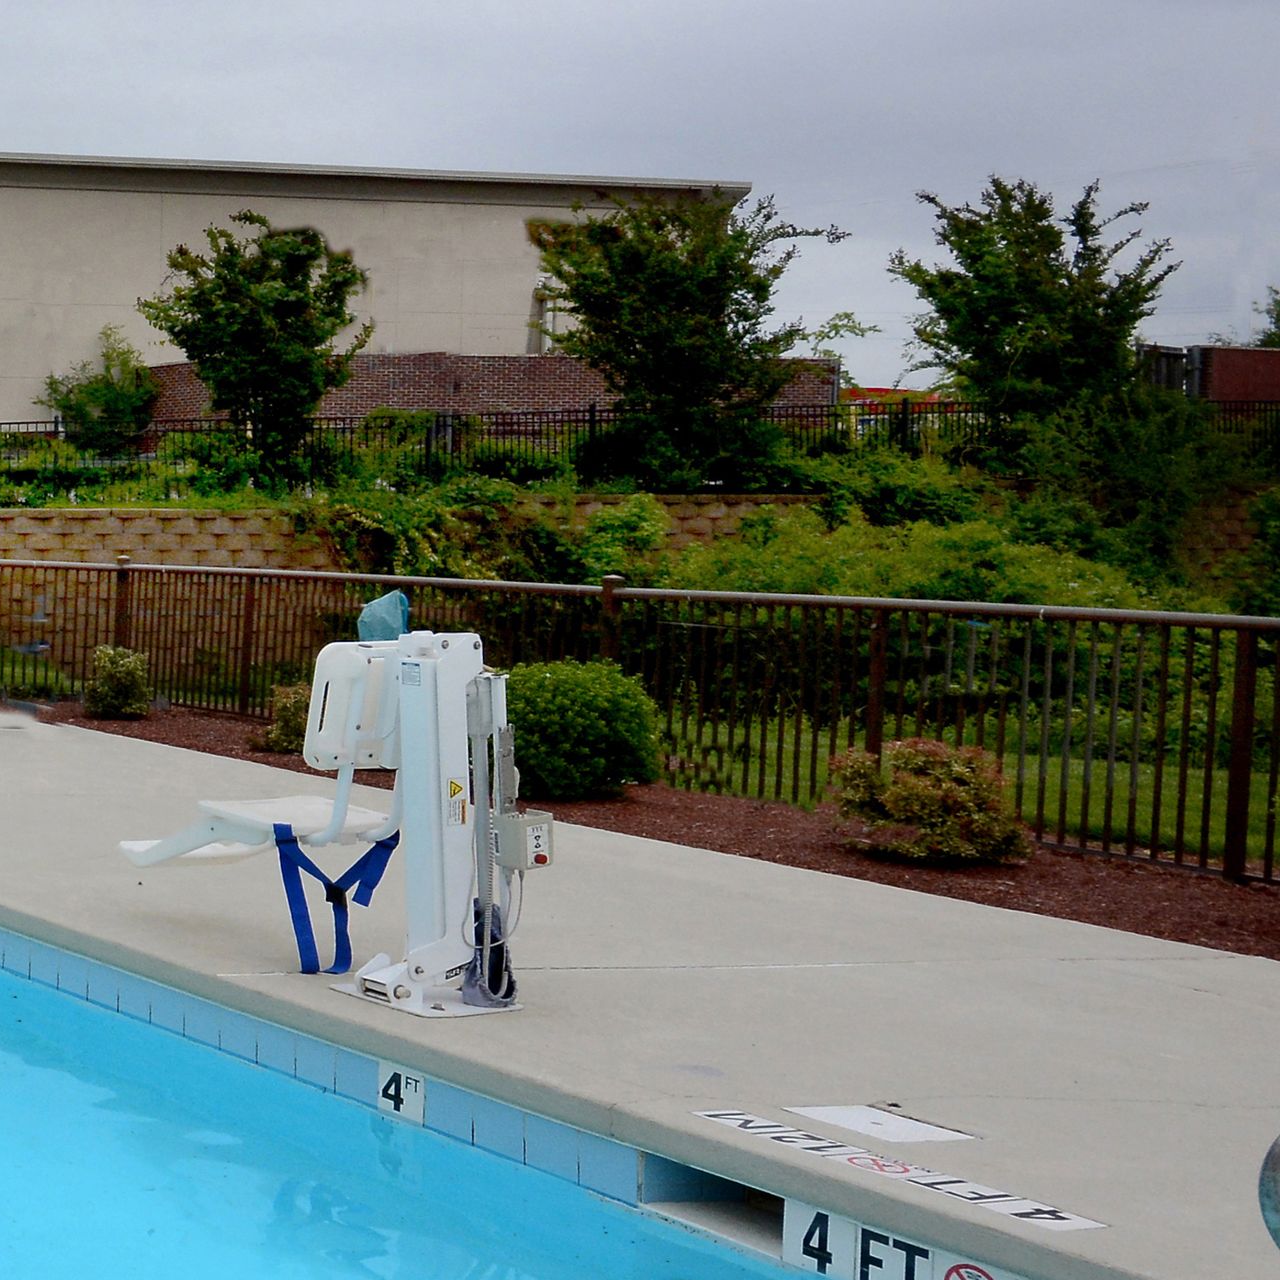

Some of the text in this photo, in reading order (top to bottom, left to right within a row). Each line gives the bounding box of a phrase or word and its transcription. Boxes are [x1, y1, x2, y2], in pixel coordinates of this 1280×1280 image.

[382, 1071, 420, 1112] 4 FT
[704, 1112, 1071, 1221] 4 FT 1.2 M
[802, 1211, 832, 1274] 4
